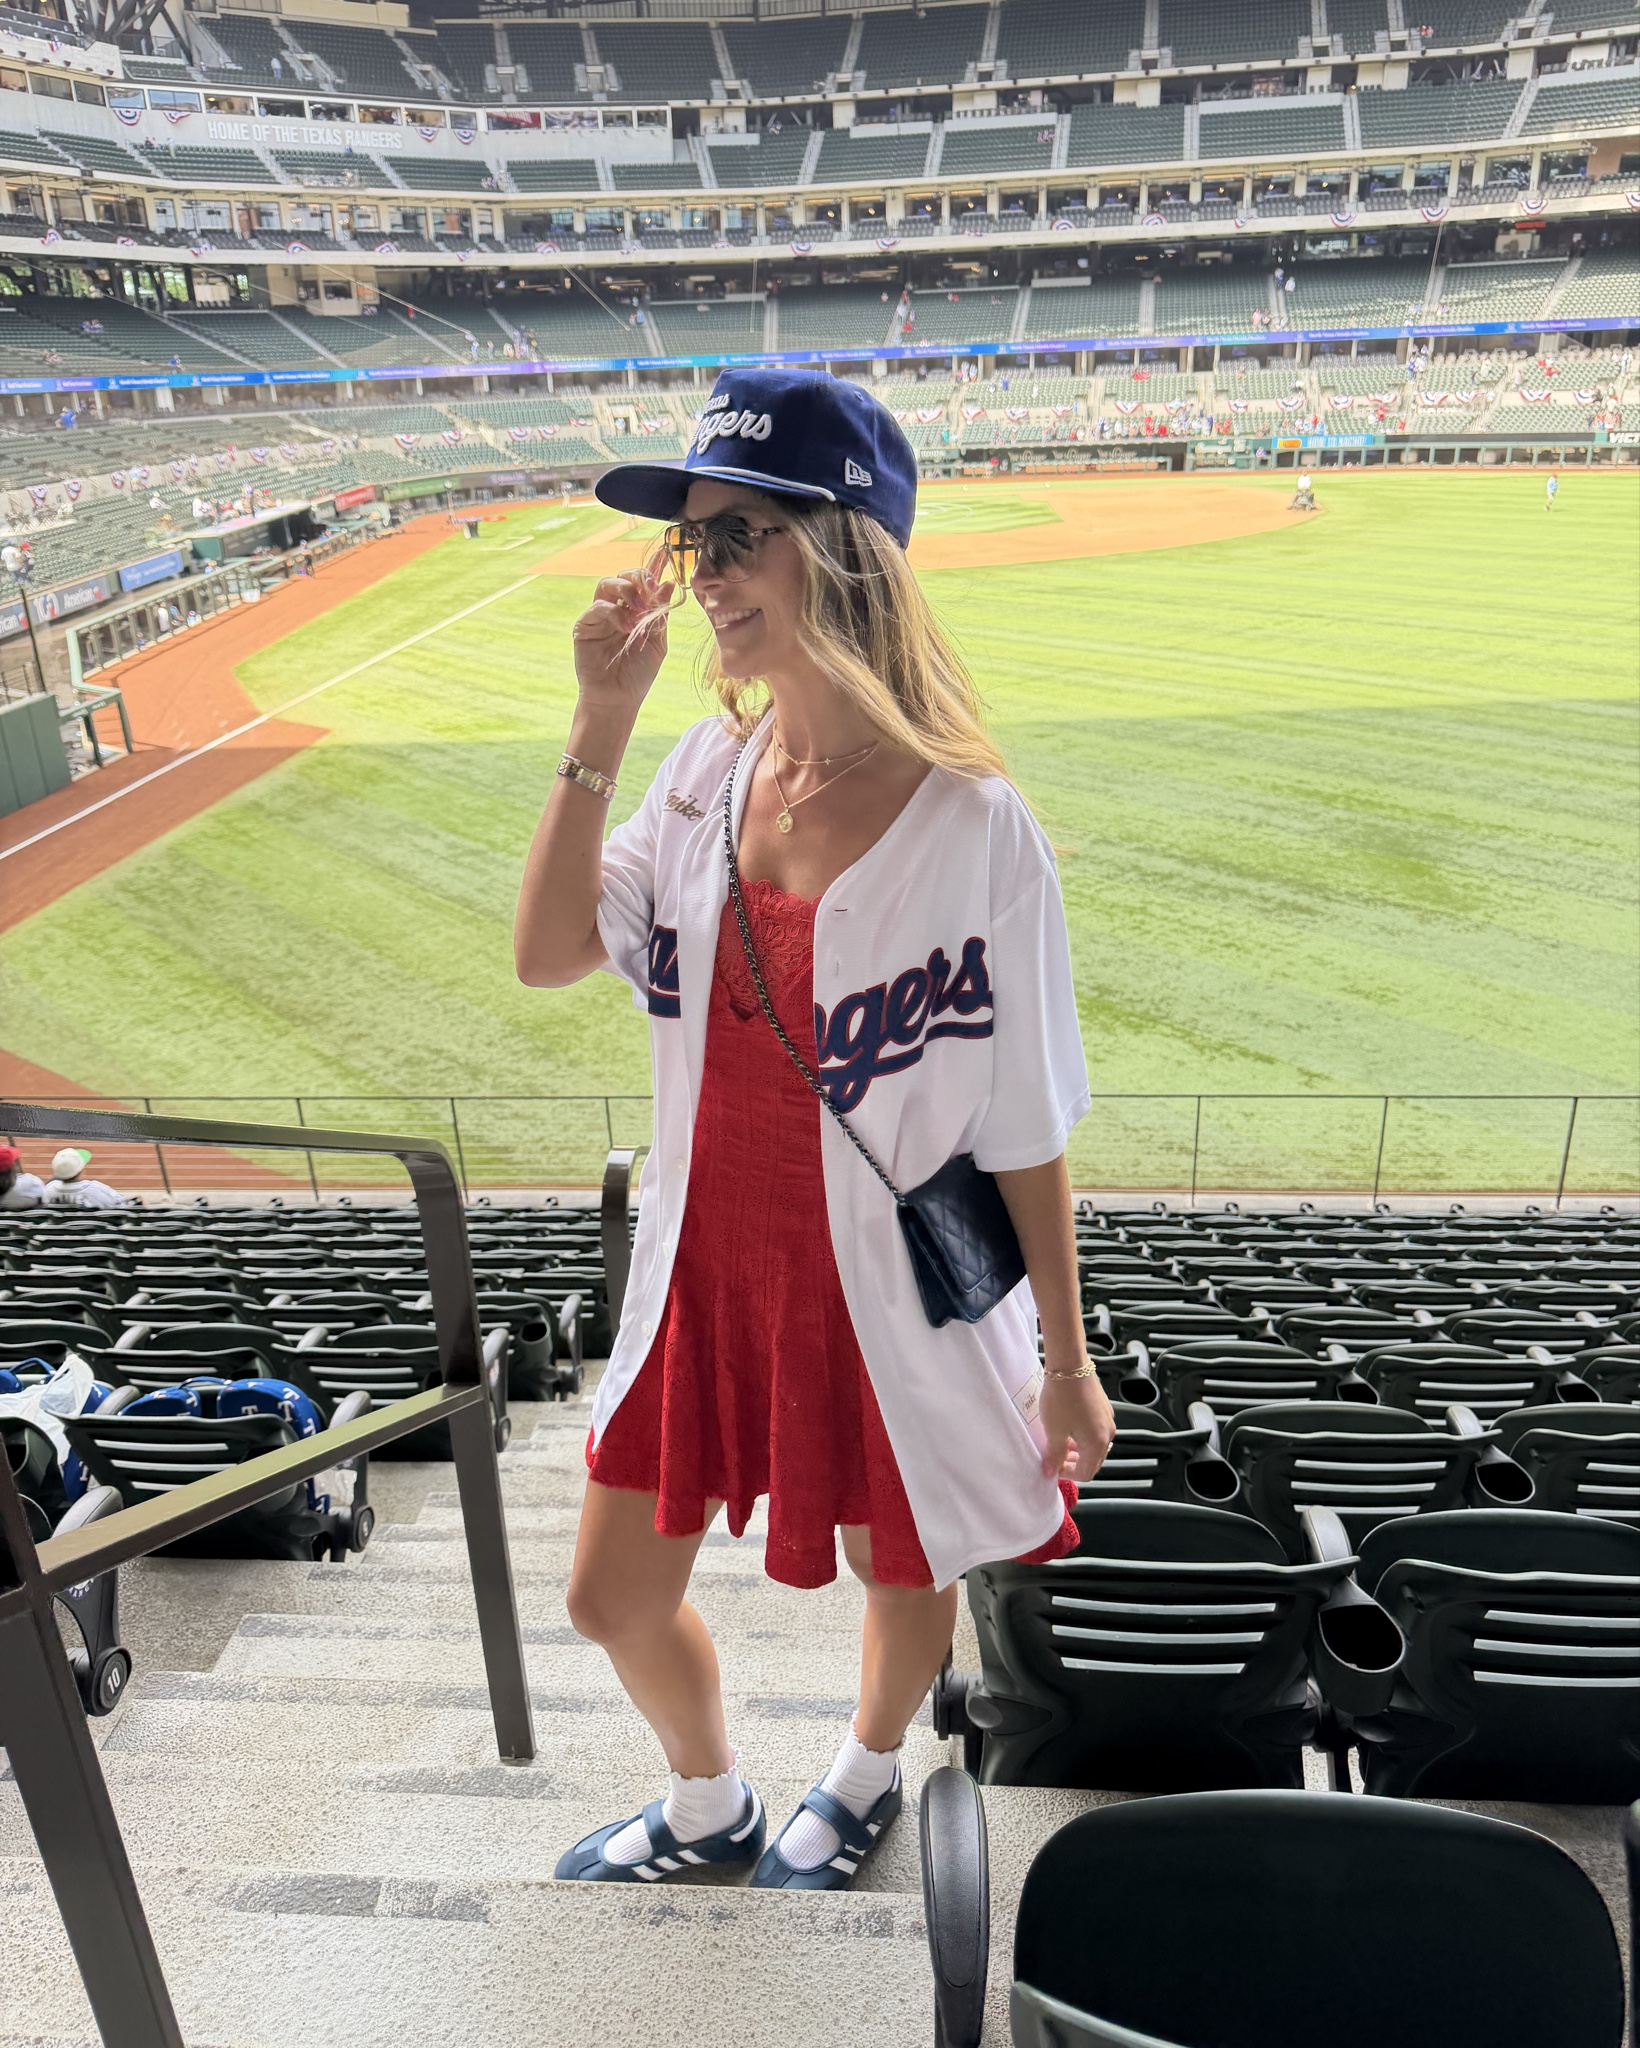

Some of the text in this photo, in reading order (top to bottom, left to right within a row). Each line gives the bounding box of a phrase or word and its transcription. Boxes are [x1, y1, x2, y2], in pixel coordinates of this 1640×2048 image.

[207, 121, 403, 149] HOME OF THE TEXAS RANGERS
[64, 586, 95, 609] American
[277, 1400, 295, 1422] T
[107, 1667, 120, 1695] 10
